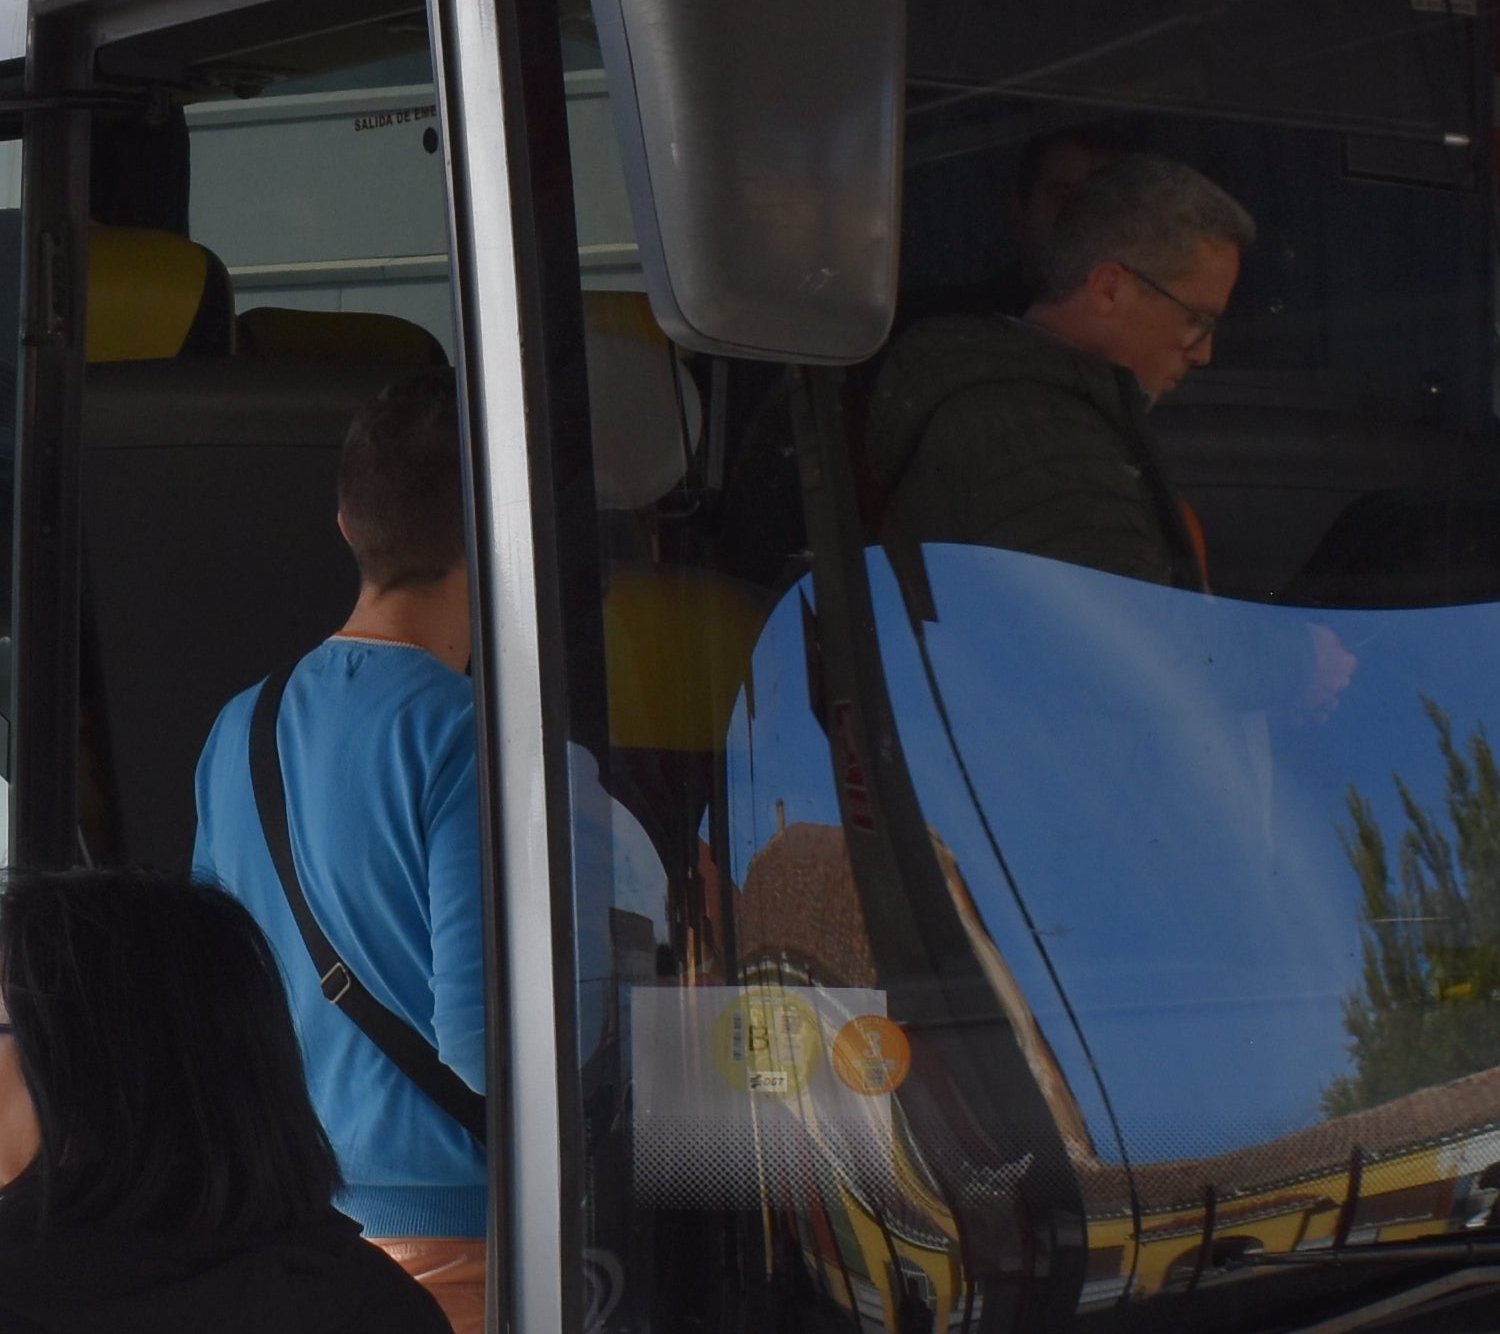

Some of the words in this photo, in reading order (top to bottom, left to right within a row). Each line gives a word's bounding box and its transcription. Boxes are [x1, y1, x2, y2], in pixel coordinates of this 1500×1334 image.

[354, 116, 393, 132] SALIDA
[396, 109, 411, 124] DE
[414, 105, 437, 120] EME
[749, 1024, 769, 1051] B
